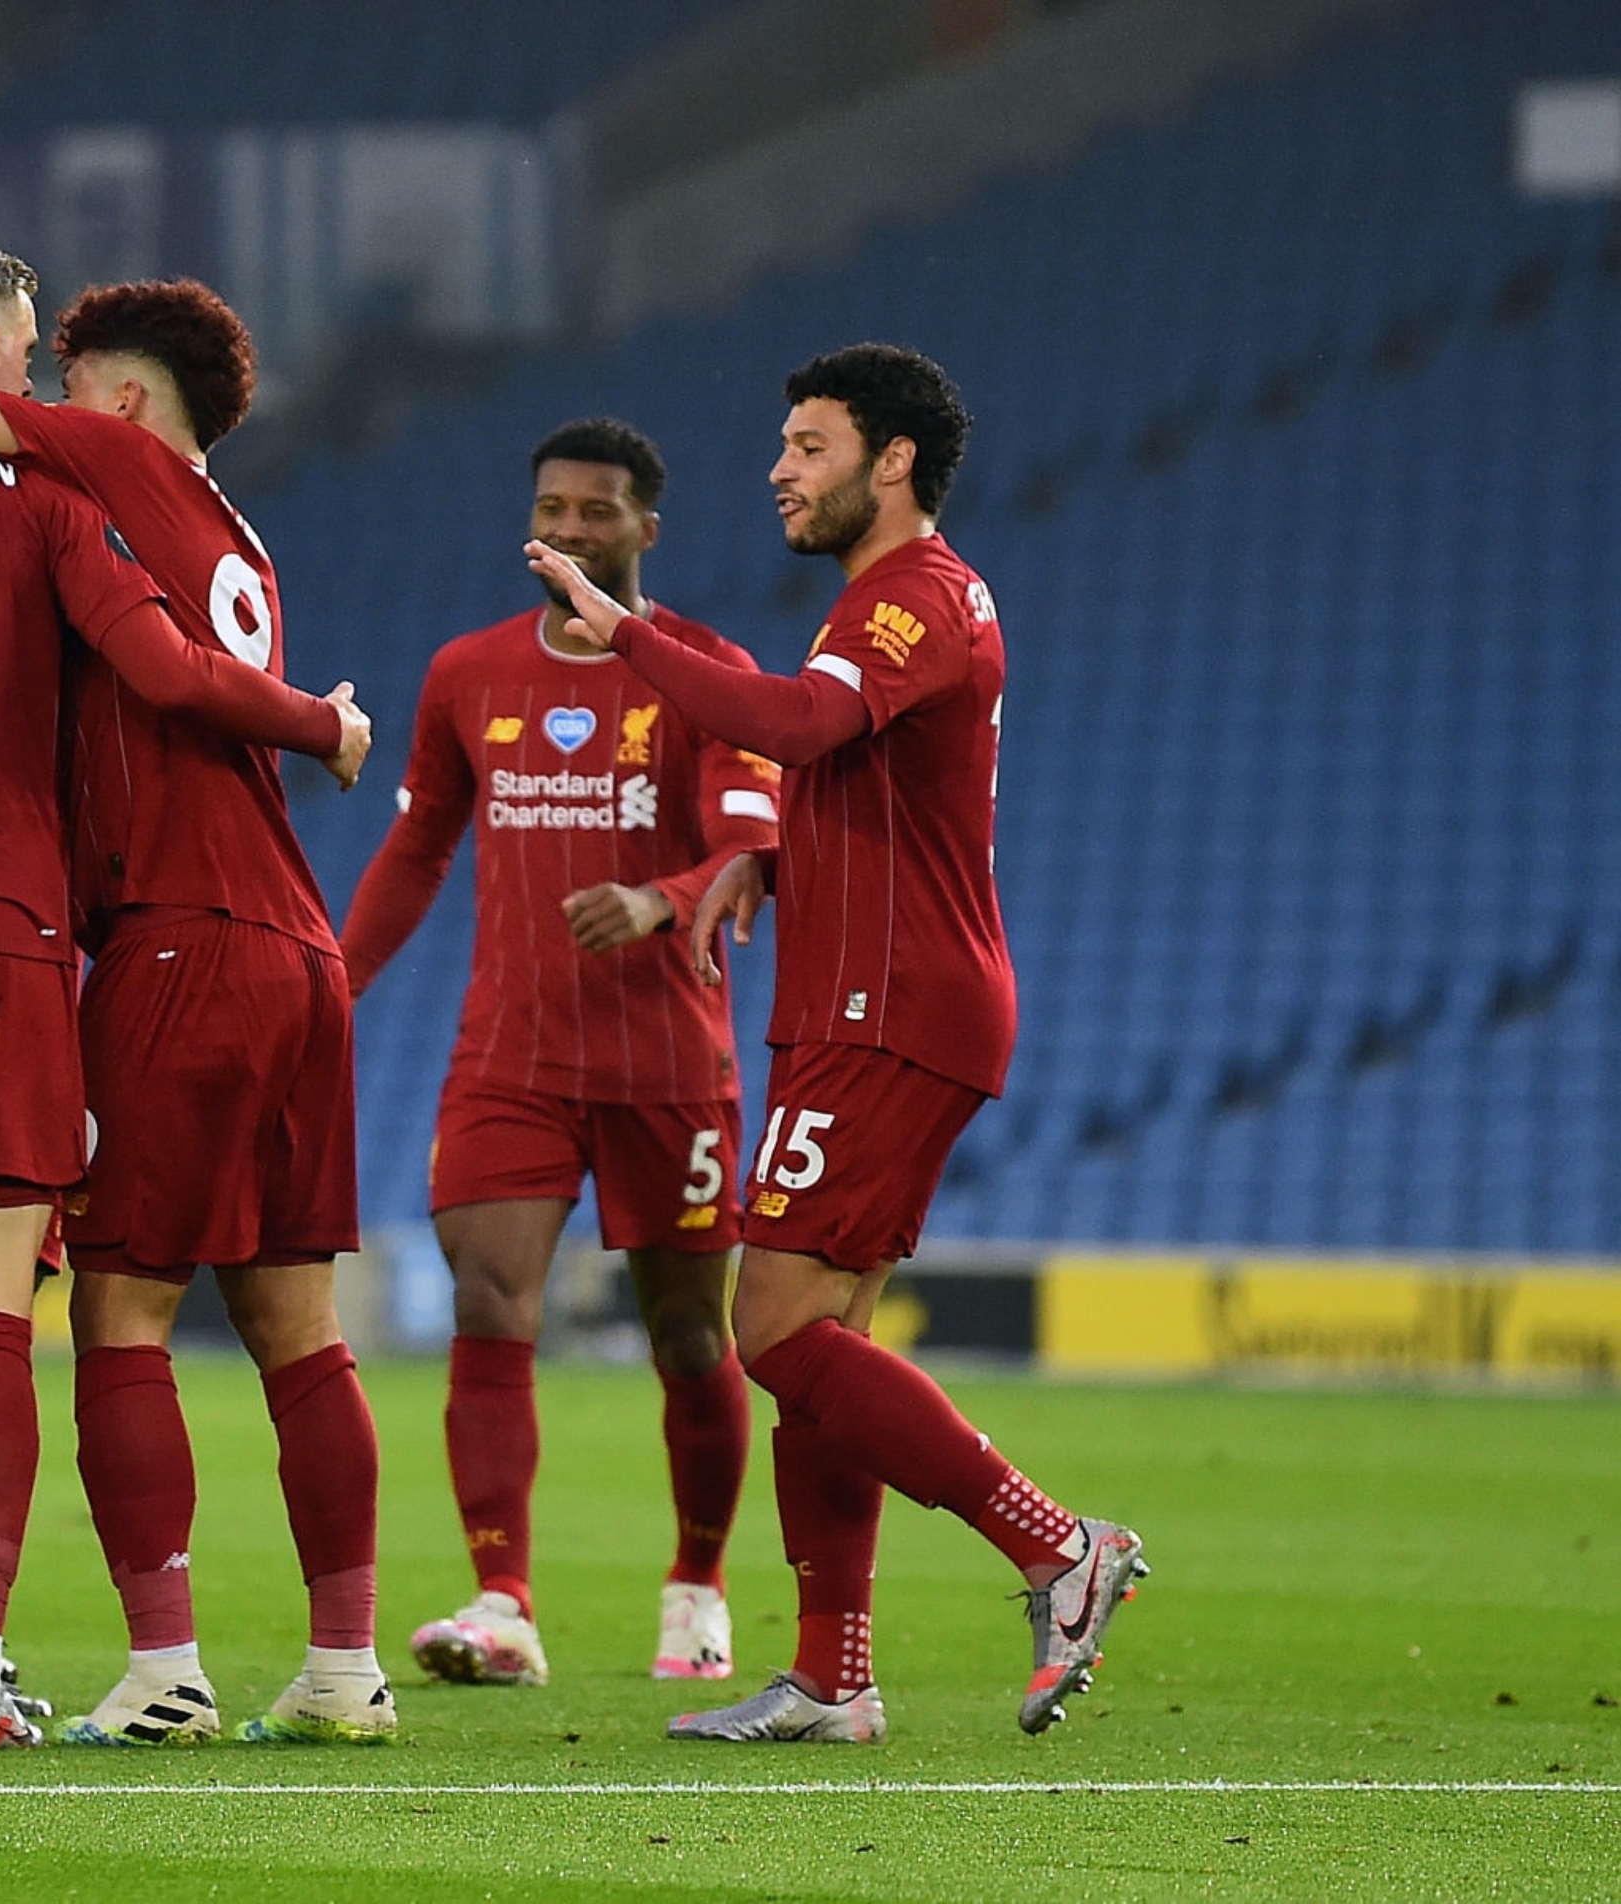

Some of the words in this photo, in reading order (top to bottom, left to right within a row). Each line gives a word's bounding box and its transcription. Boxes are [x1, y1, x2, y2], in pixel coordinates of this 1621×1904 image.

[873, 601, 926, 645] WU
[491, 769, 614, 799] Standard
[488, 801, 614, 830] Chartered
[683, 1128, 723, 1205] 5
[756, 1106, 835, 1189] 15
